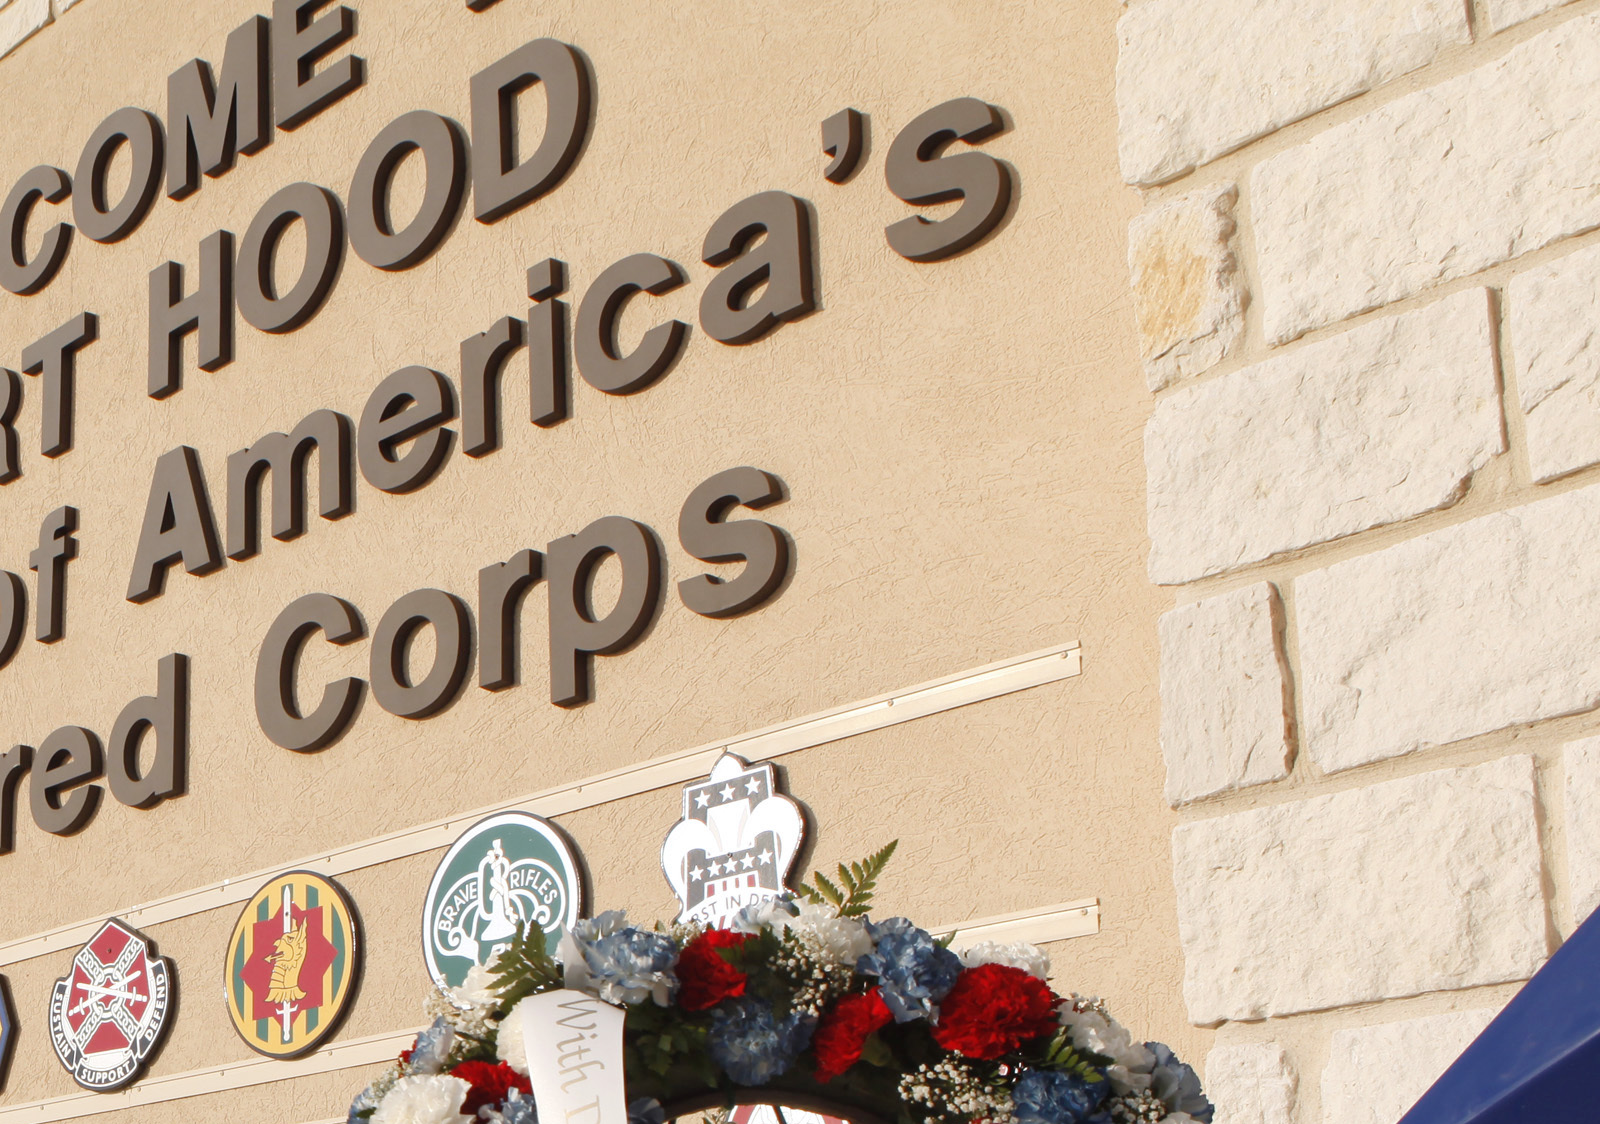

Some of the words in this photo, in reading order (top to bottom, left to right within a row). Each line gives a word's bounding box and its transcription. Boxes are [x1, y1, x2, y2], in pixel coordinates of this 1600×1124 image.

[148, 37, 598, 400] HOOD
[126, 97, 1021, 602] America's
[254, 466, 799, 754] Corps
[438, 881, 478, 932] BRAVE
[509, 869, 558, 905] RIFLES
[50, 991, 72, 1059] SUSTAIN
[143, 972, 166, 1043] DEFEND
[555, 996, 605, 1095] With
[80, 1059, 131, 1084] SUPPORT
